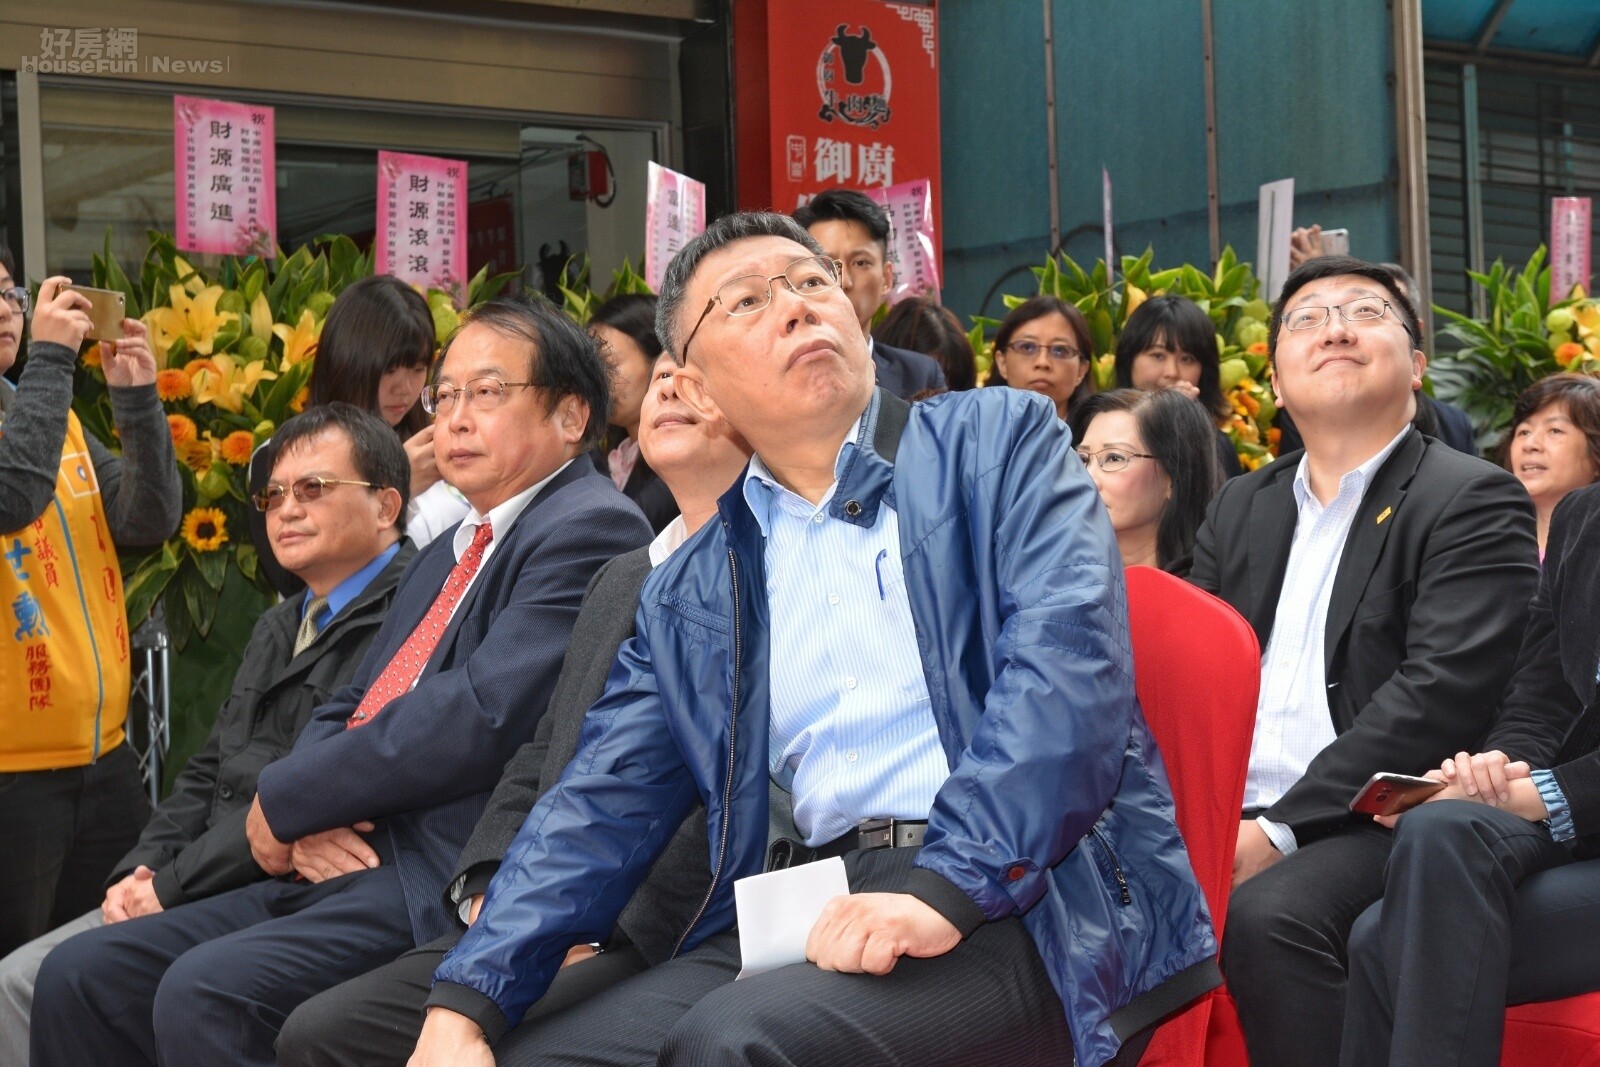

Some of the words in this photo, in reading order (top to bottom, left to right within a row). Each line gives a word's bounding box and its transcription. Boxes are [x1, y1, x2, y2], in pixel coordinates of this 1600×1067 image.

[251, 113, 266, 125] 祝
[209, 120, 234, 223] 財源廣進
[446, 167, 460, 178] 祝
[813, 137, 895, 188] 御廚
[408, 174, 430, 273] 財源滾滾
[26, 643, 53, 711] 服務團隊
